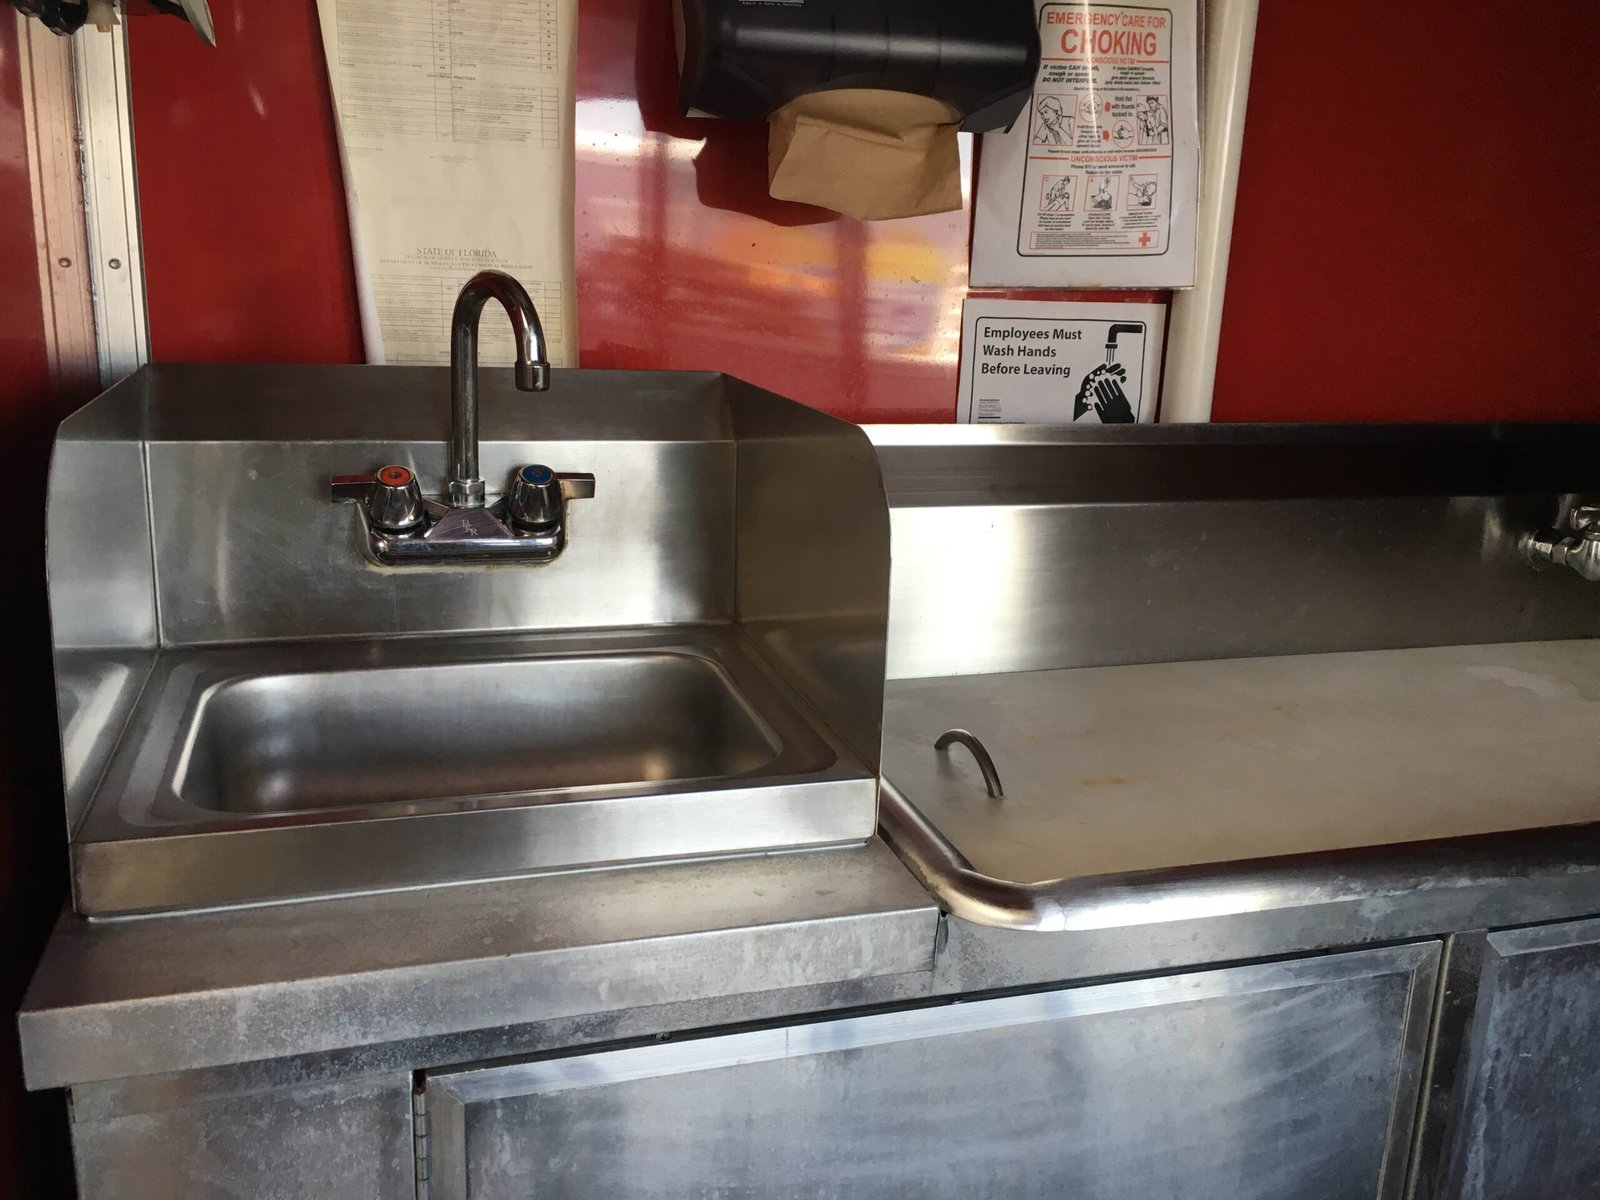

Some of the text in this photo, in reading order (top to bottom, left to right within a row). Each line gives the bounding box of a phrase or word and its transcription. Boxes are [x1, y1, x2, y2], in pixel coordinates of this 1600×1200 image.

[1046, 12, 1166, 29] EMERGENCY CARE FOR
[1061, 28, 1156, 56] CHOKING
[458, 249, 497, 257] FLORIDA
[984, 326, 1082, 341] Employees Must
[983, 344, 1057, 357] Wash Hands
[981, 363, 1071, 378] Before Leaving
